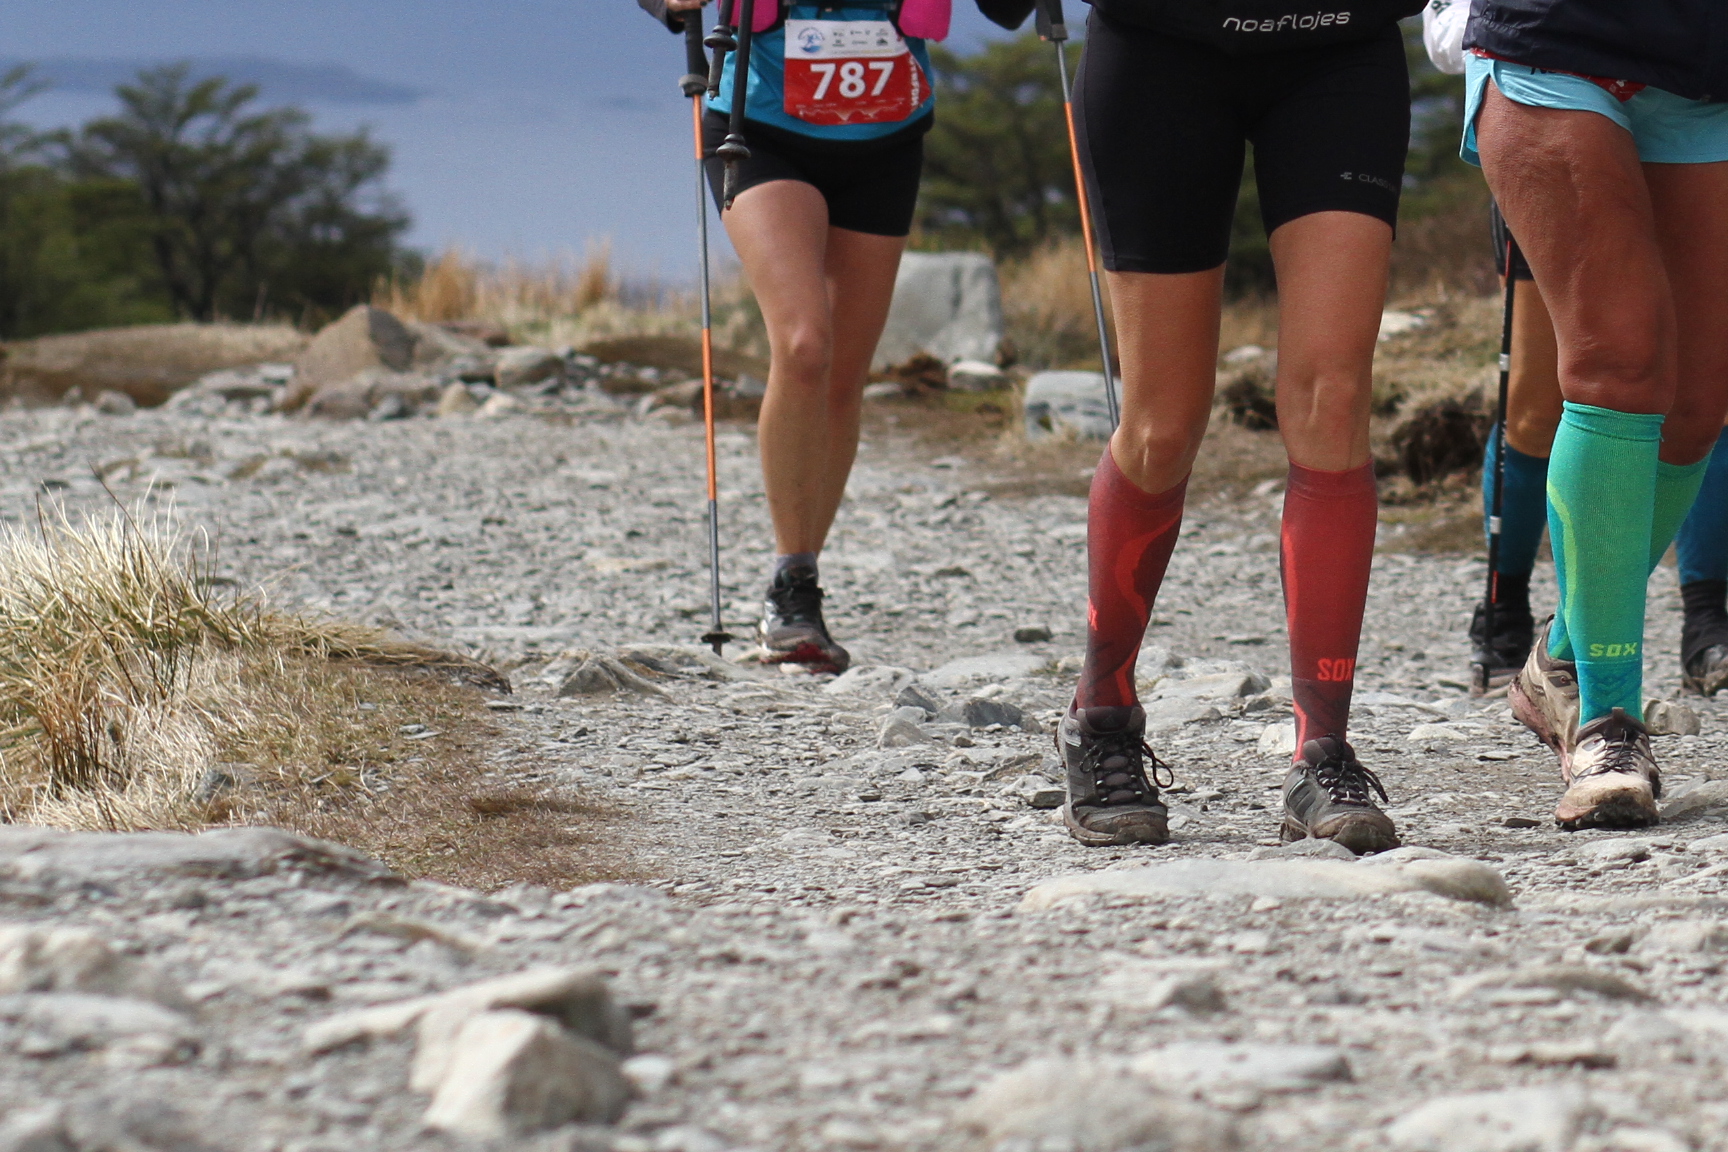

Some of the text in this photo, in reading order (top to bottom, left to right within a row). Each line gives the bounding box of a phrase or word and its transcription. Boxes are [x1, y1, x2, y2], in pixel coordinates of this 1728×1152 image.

[1222, 10, 1351, 32] noaflojes
[810, 61, 895, 100] 787
[1589, 642, 1638, 657] SOX
[1317, 658, 1355, 682] SOX
